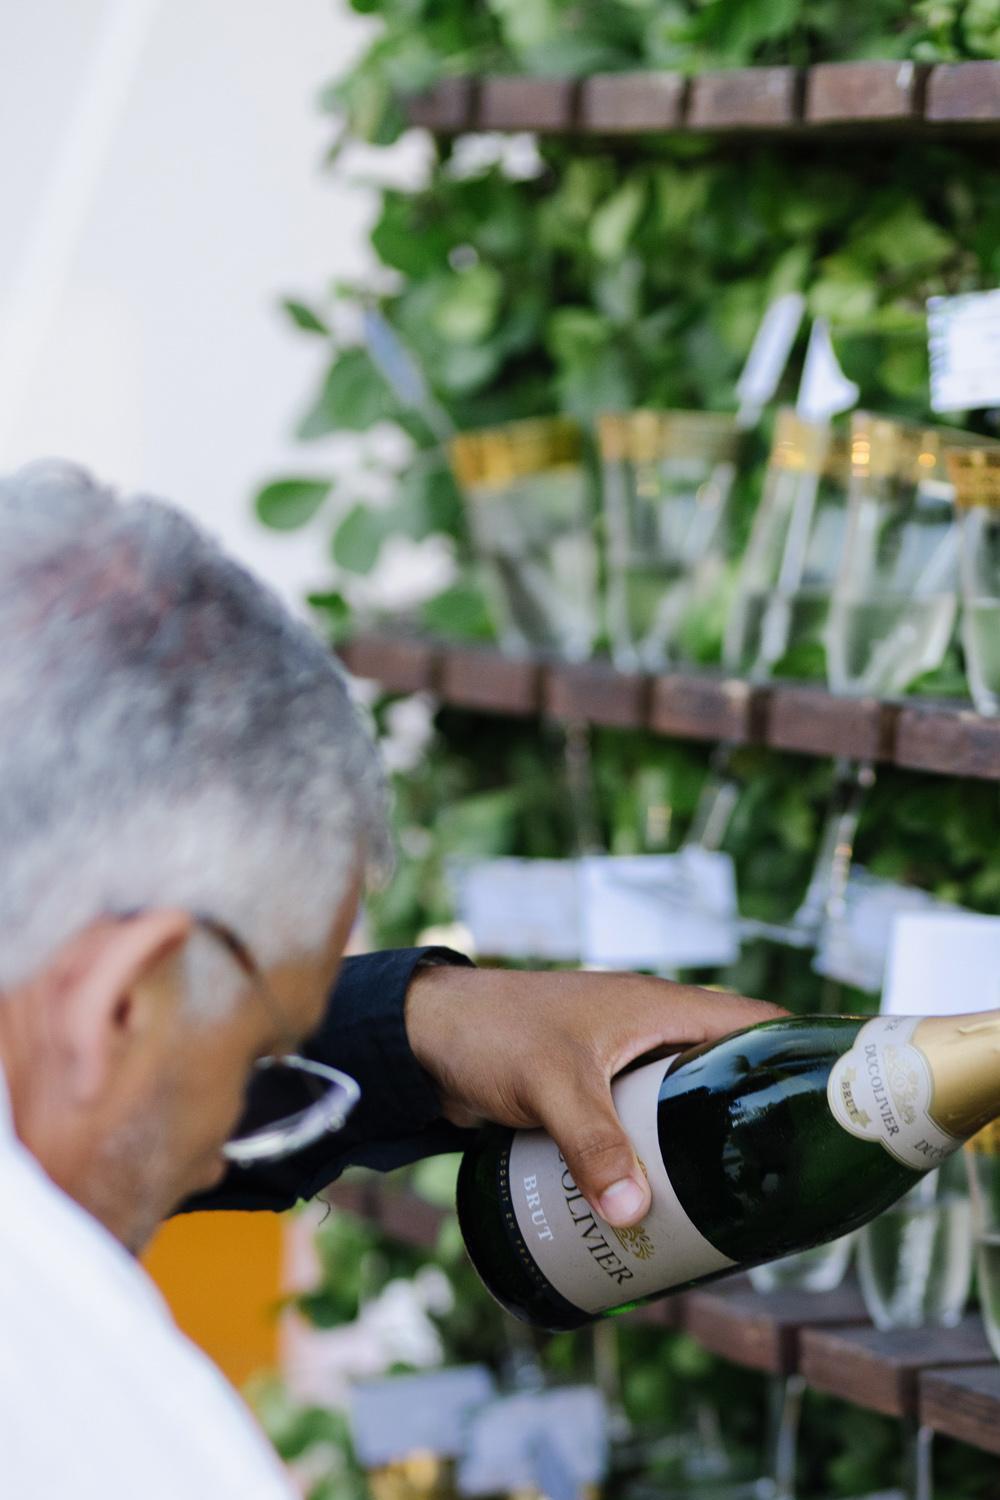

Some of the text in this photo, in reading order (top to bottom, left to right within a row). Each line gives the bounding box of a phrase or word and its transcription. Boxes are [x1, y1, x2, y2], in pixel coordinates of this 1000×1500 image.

[842, 1081, 859, 1116] BRUT
[524, 1175, 555, 1241] BRUT
[559, 1151, 634, 1286] OLIVIER
